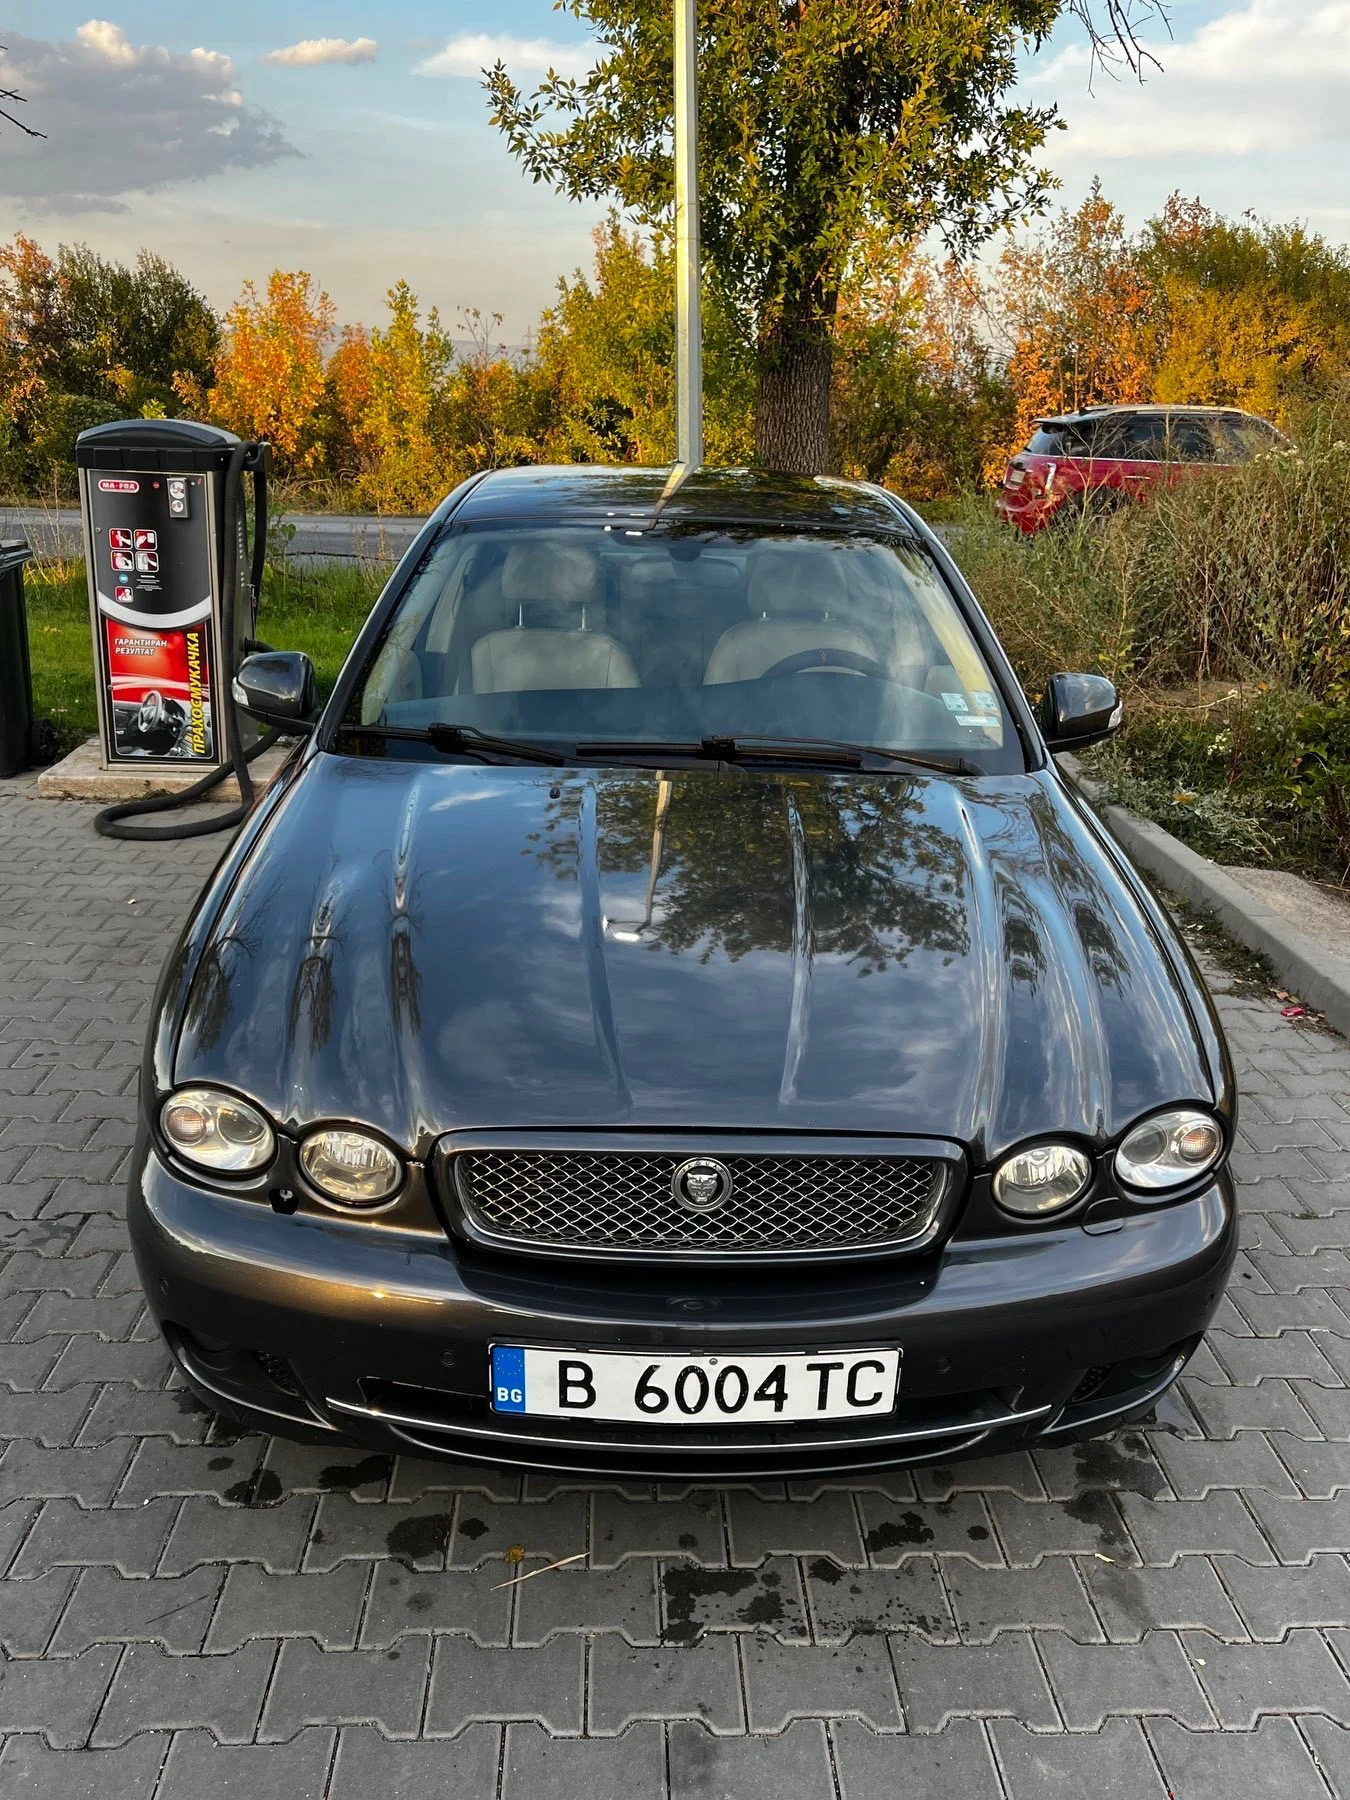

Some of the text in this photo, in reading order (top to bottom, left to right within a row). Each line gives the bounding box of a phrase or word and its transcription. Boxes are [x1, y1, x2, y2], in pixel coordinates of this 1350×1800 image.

[114, 638, 168, 648] ГАРАНТИРАН
[115, 647, 154, 656] РЕЗУЛТАТ
[187, 632, 206, 754] ПРАХОСМУКАЧКА
[497, 1387, 523, 1404] BG
[558, 1360, 886, 1415] B 6004 TC
